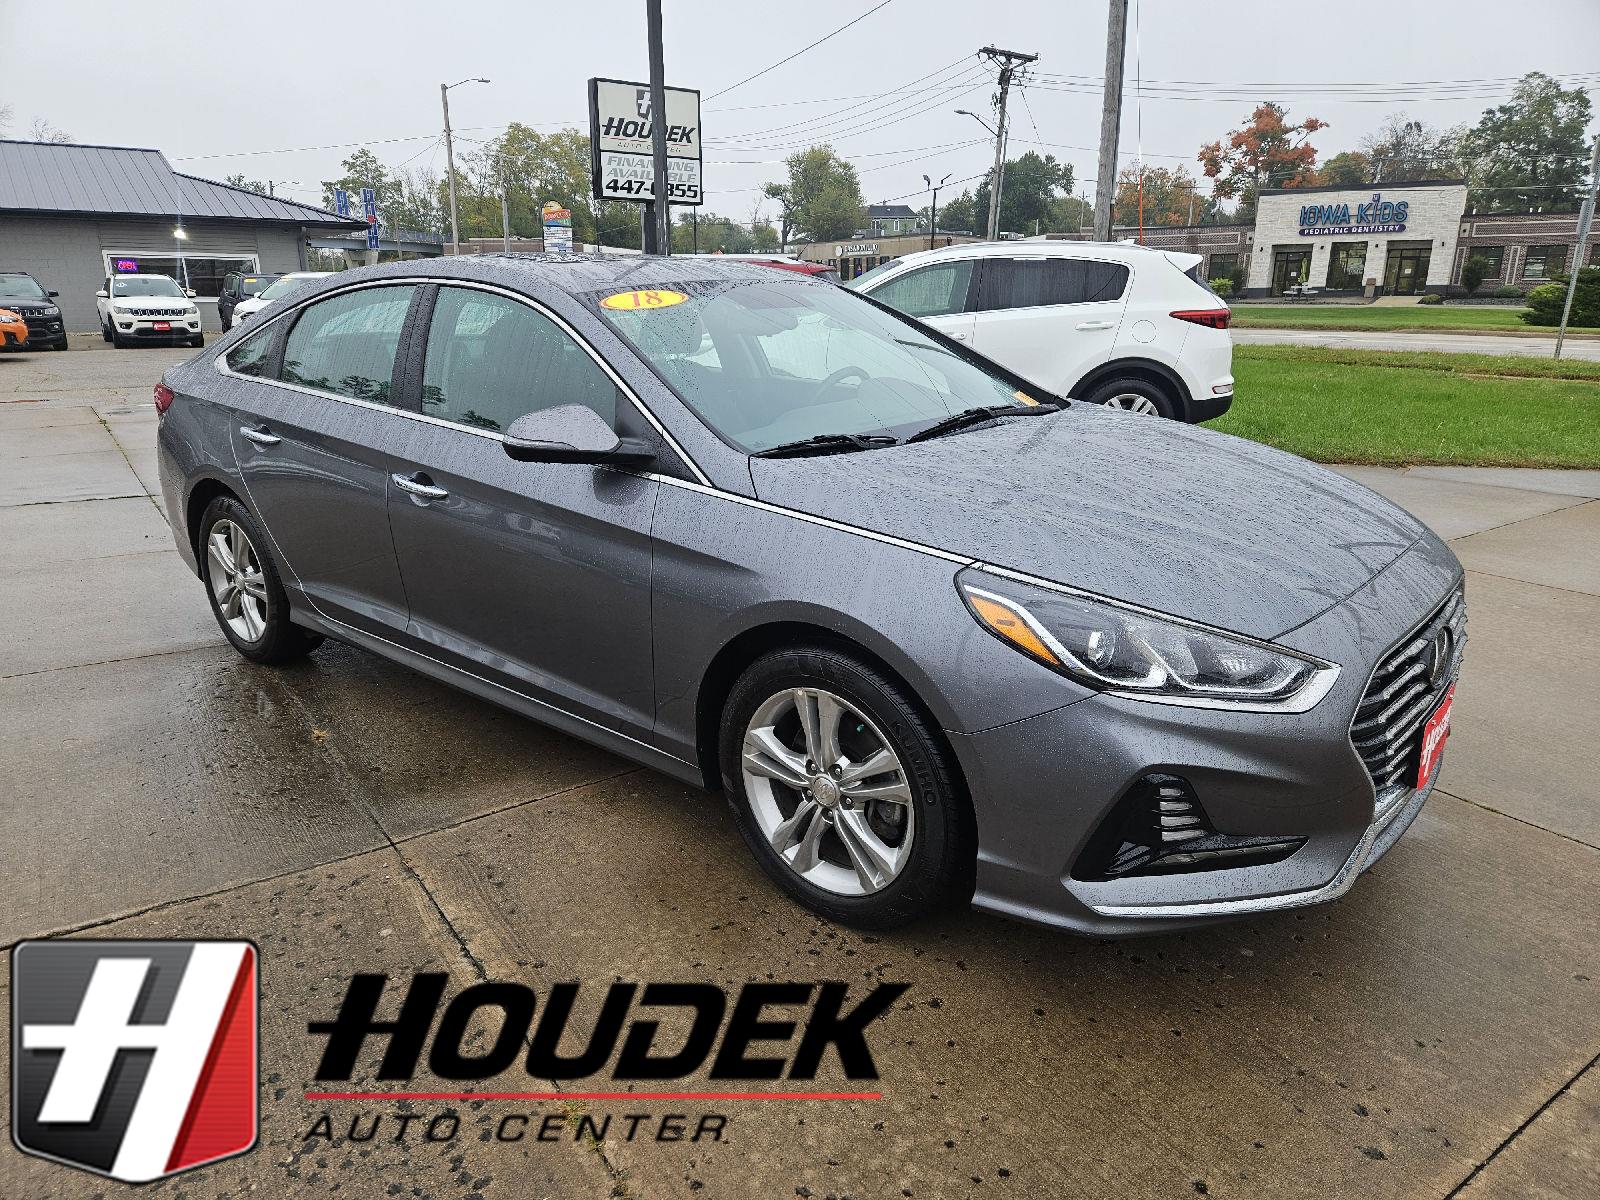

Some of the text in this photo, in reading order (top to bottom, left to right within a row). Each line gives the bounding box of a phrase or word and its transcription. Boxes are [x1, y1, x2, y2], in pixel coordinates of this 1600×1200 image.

[602, 117, 696, 143] HOUEK
[607, 156, 695, 172] FINANING
[606, 168, 697, 183] AVAILBLE
[1299, 204, 1350, 226] IOWA
[1352, 225, 1400, 233] DENTISTRY
[632, 291, 663, 307] 18
